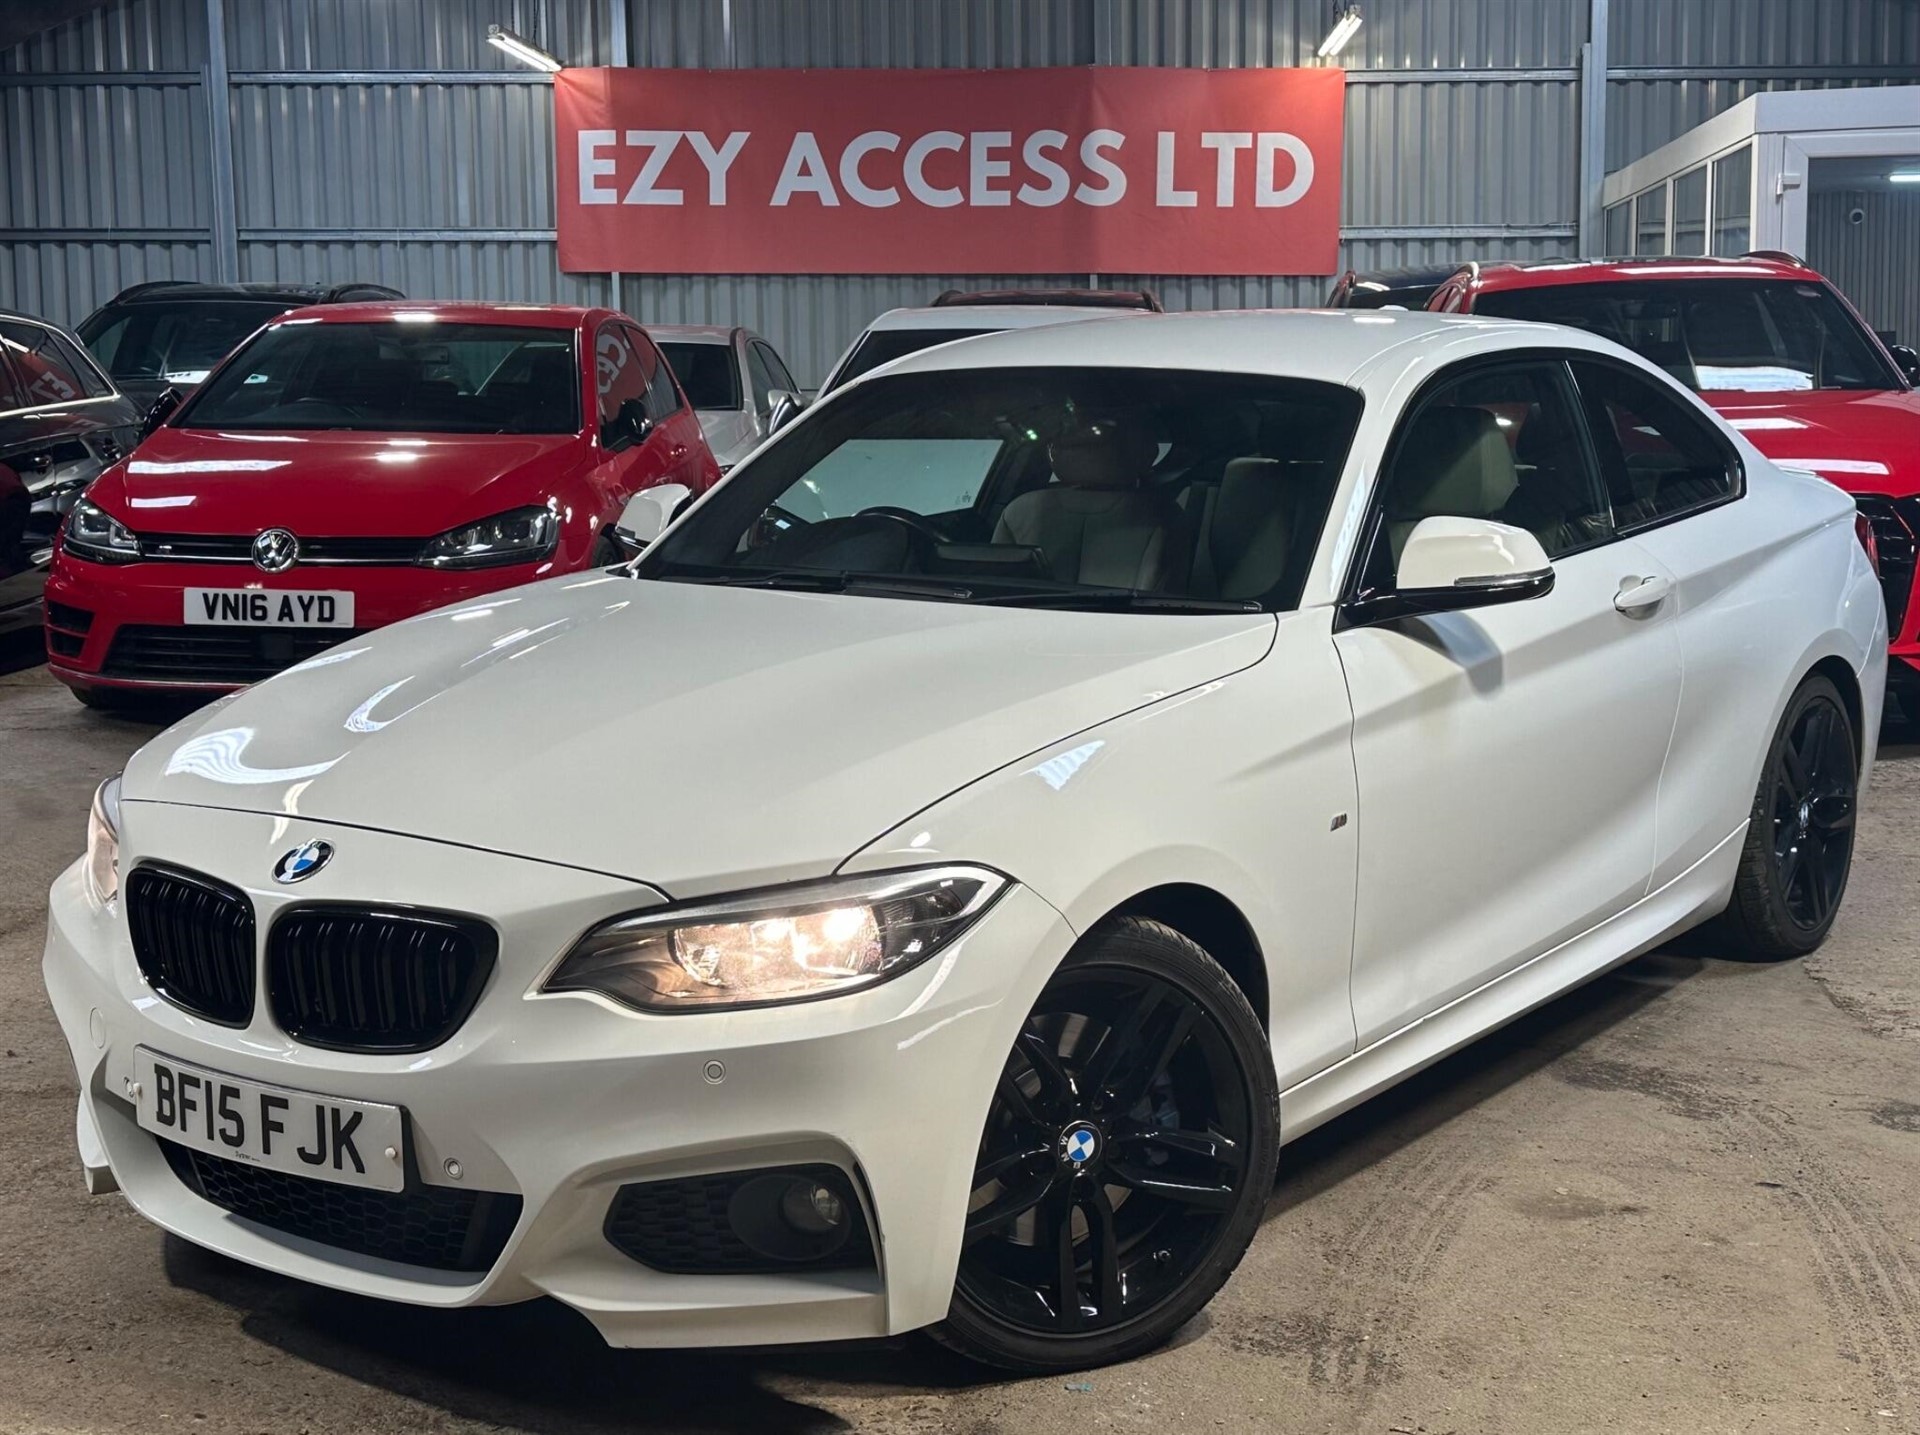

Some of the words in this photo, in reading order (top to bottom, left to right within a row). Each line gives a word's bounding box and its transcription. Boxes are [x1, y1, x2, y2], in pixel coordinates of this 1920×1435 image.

[577, 129, 751, 206] EZY
[769, 128, 1128, 208] ACCESS
[1155, 131, 1315, 208] LTD
[202, 592, 268, 621] VN16
[277, 594, 335, 623] AYD
[154, 1063, 245, 1148] BF15
[260, 1093, 366, 1174] FJK
